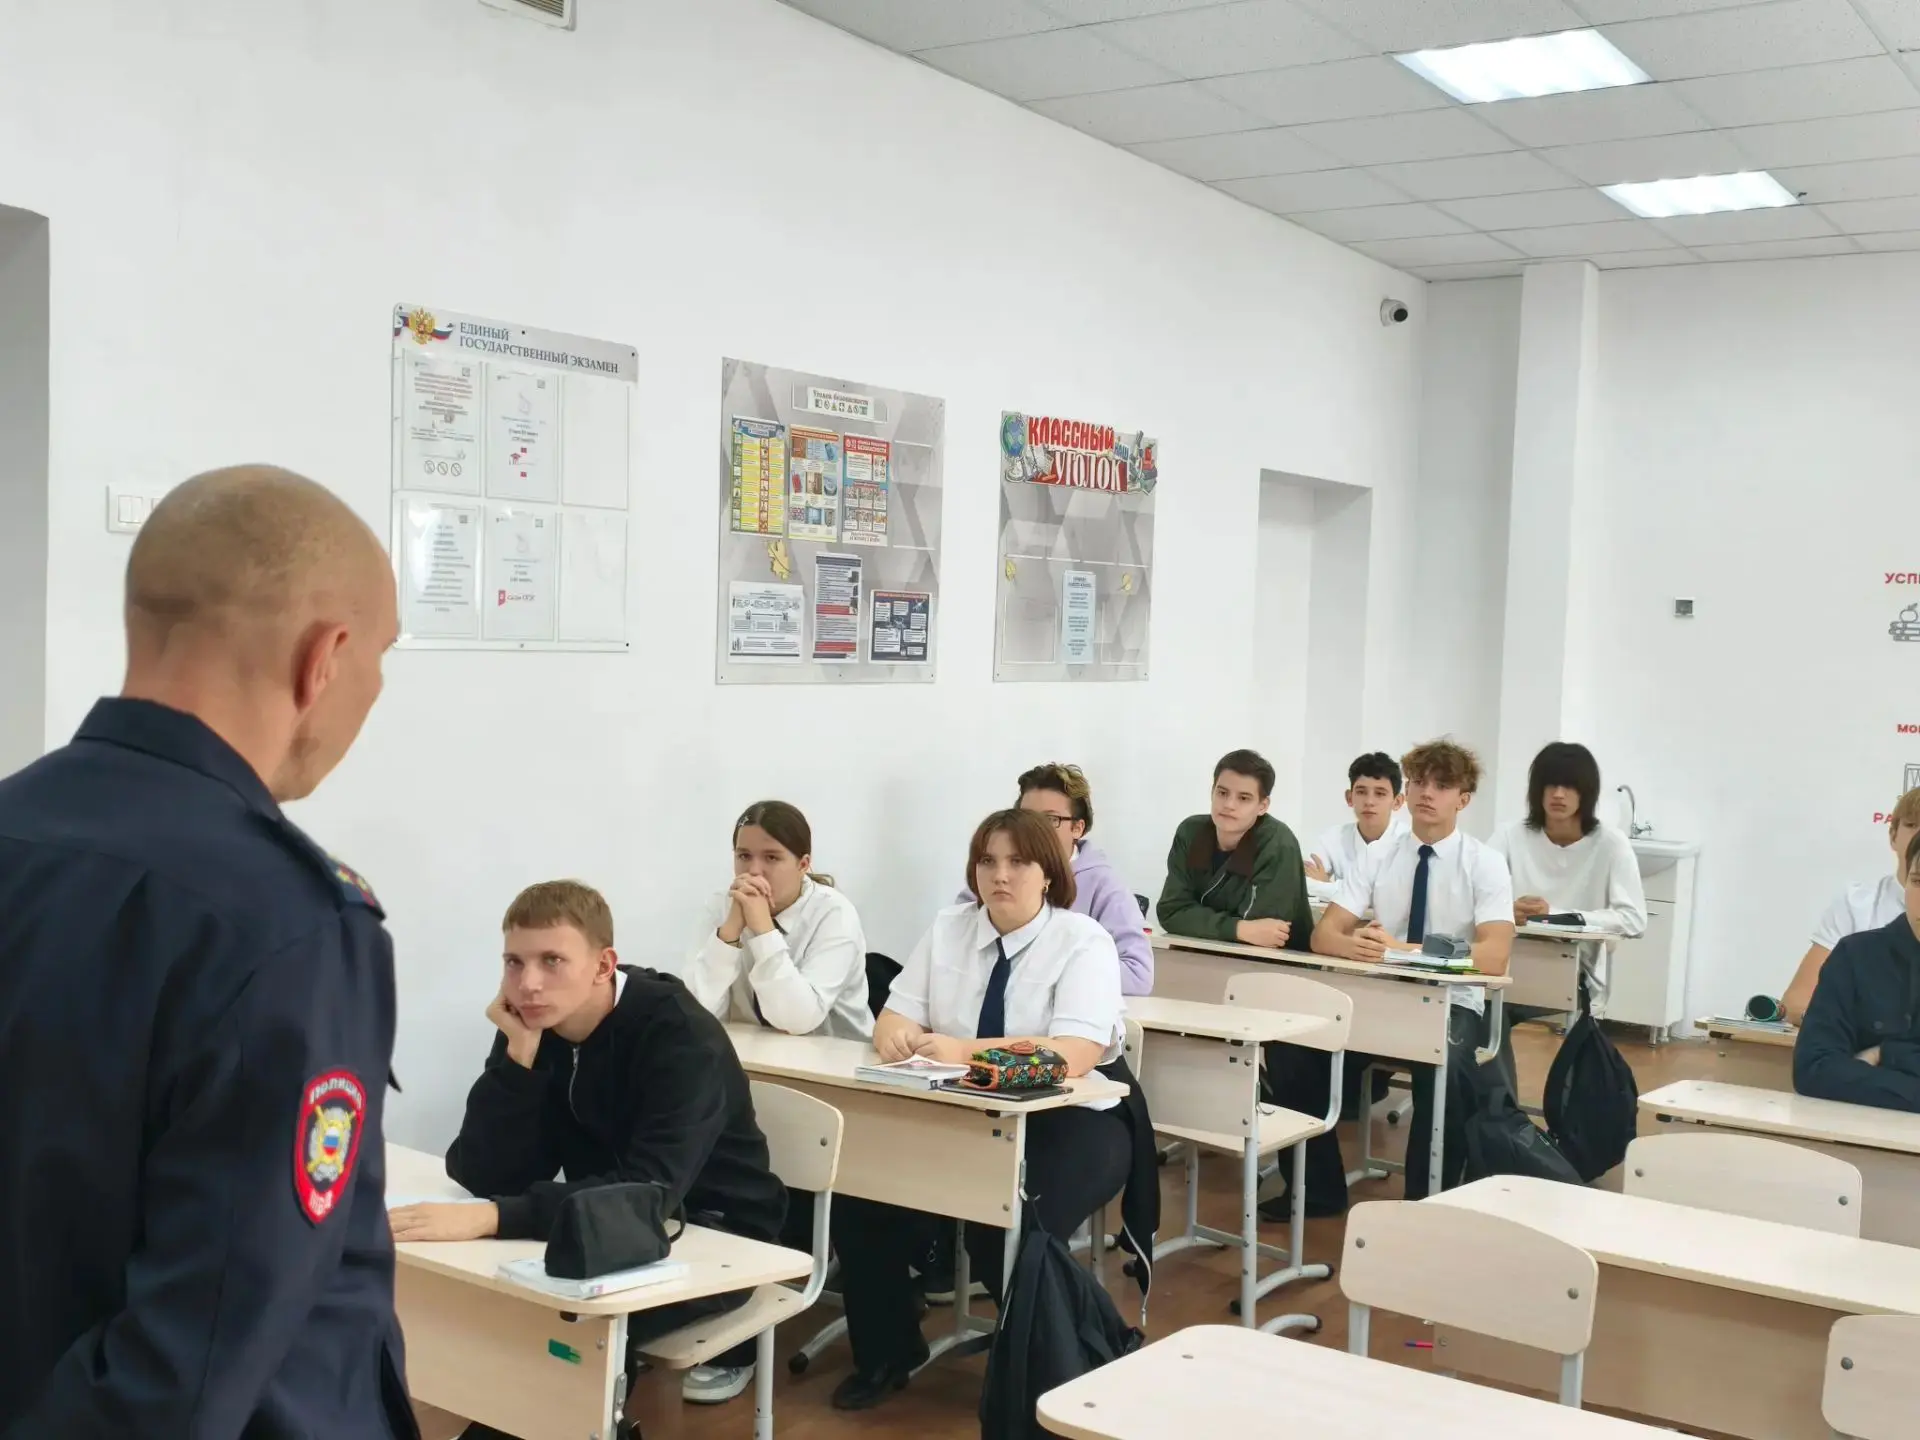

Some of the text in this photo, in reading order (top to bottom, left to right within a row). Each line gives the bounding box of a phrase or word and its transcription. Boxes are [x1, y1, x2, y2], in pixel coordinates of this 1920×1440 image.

[460, 322, 509, 341] ЕДИНЫЙ
[460, 335, 618, 373] ГОСУДАРСТВЕННЫЙ ЭКЗАМЕН
[1028, 416, 1115, 452] КЛАССНЫЙ
[1055, 450, 1122, 492] УГОЛОК
[1884, 572, 1920, 585] УСП
[1897, 723, 1920, 734] МО
